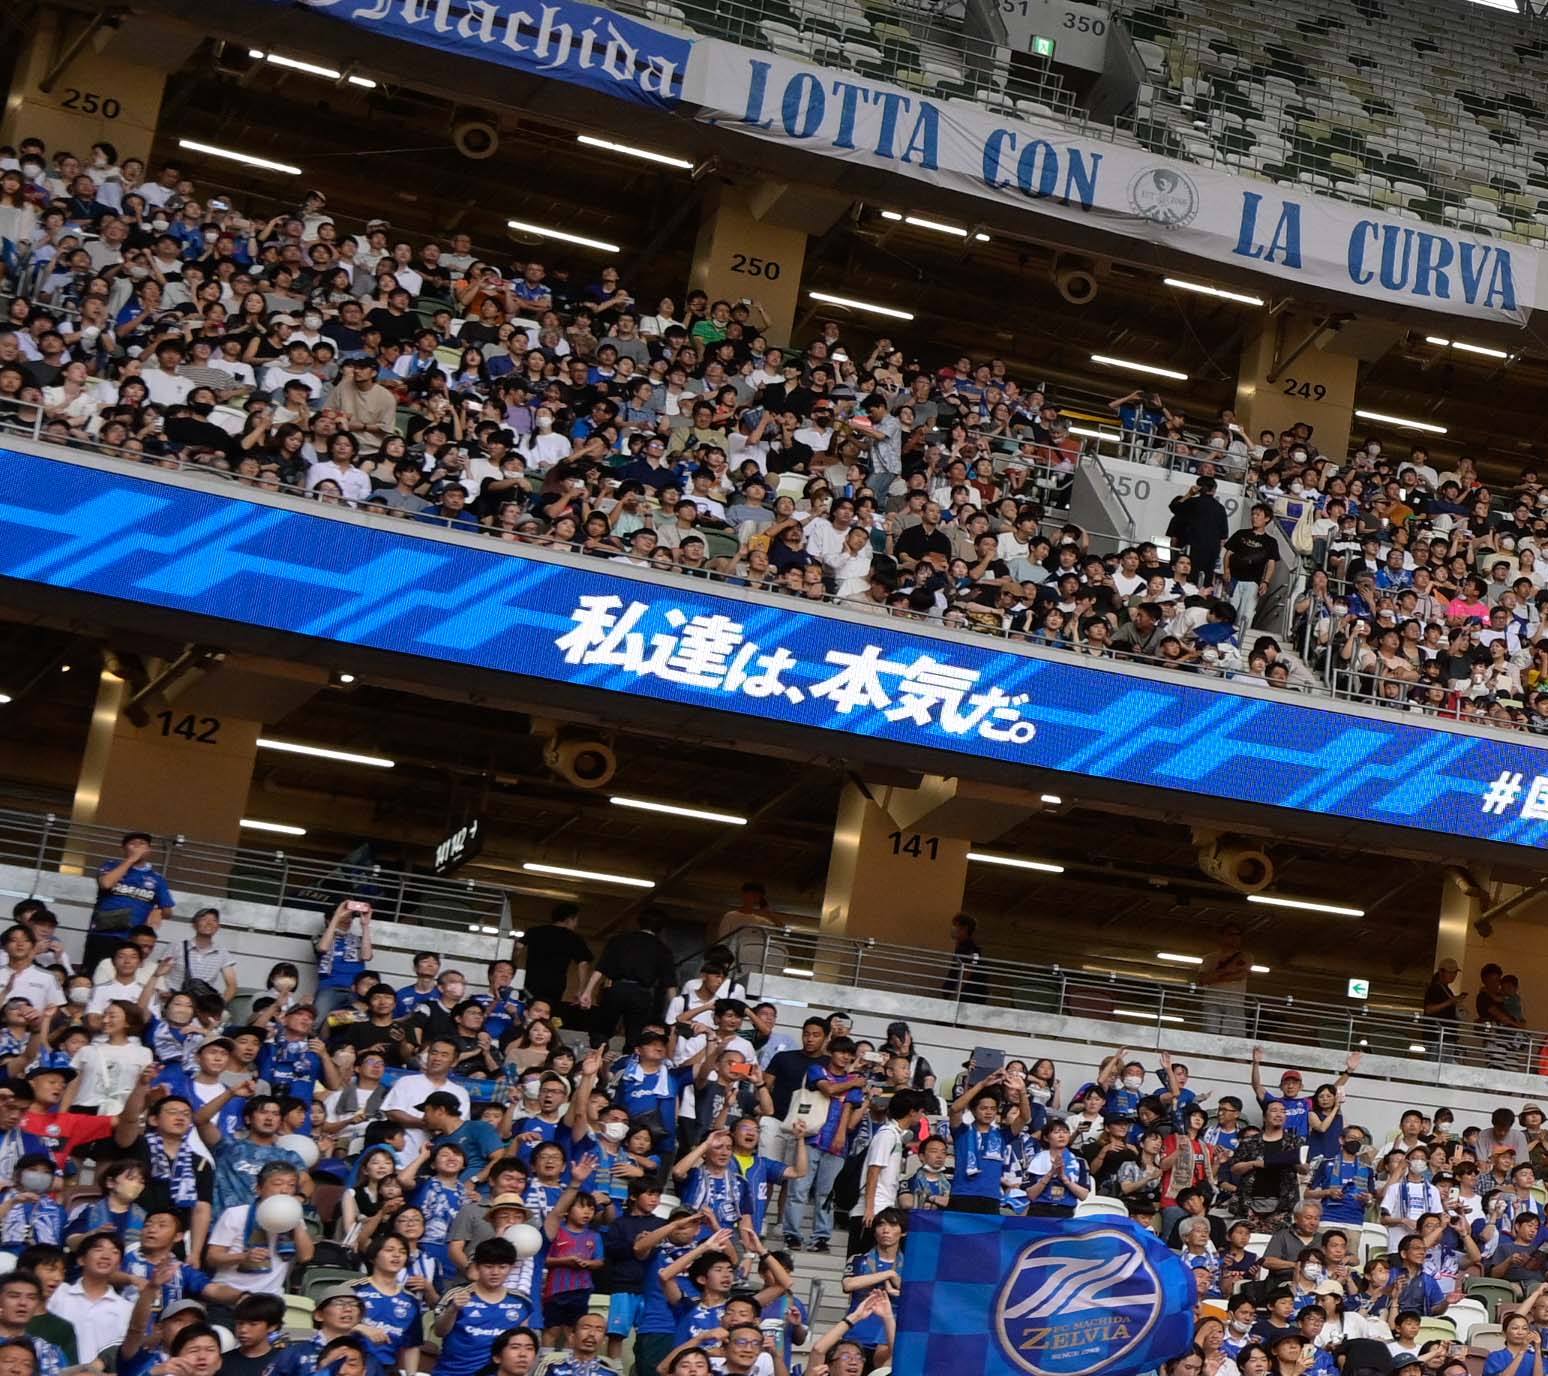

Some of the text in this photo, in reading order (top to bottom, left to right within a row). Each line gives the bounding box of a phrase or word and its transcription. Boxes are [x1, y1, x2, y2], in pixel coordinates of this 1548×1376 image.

[1062, 13, 1106, 37] 350
[61, 87, 121, 119] 250
[742, 59, 940, 171] LOTTA
[980, 127, 1103, 213] CON
[1232, 190, 1304, 270] LA
[1347, 219, 1519, 312] CURVA
[731, 254, 781, 281] 250
[1283, 378, 1327, 402] 249
[556, 594, 1038, 746] 私達は、本気だ。
[159, 709, 221, 745] 142
[889, 830, 940, 861] 141
[1020, 1324, 1131, 1351] ZELVIA
[1070, 1315, 1131, 1332] MACHIDA
